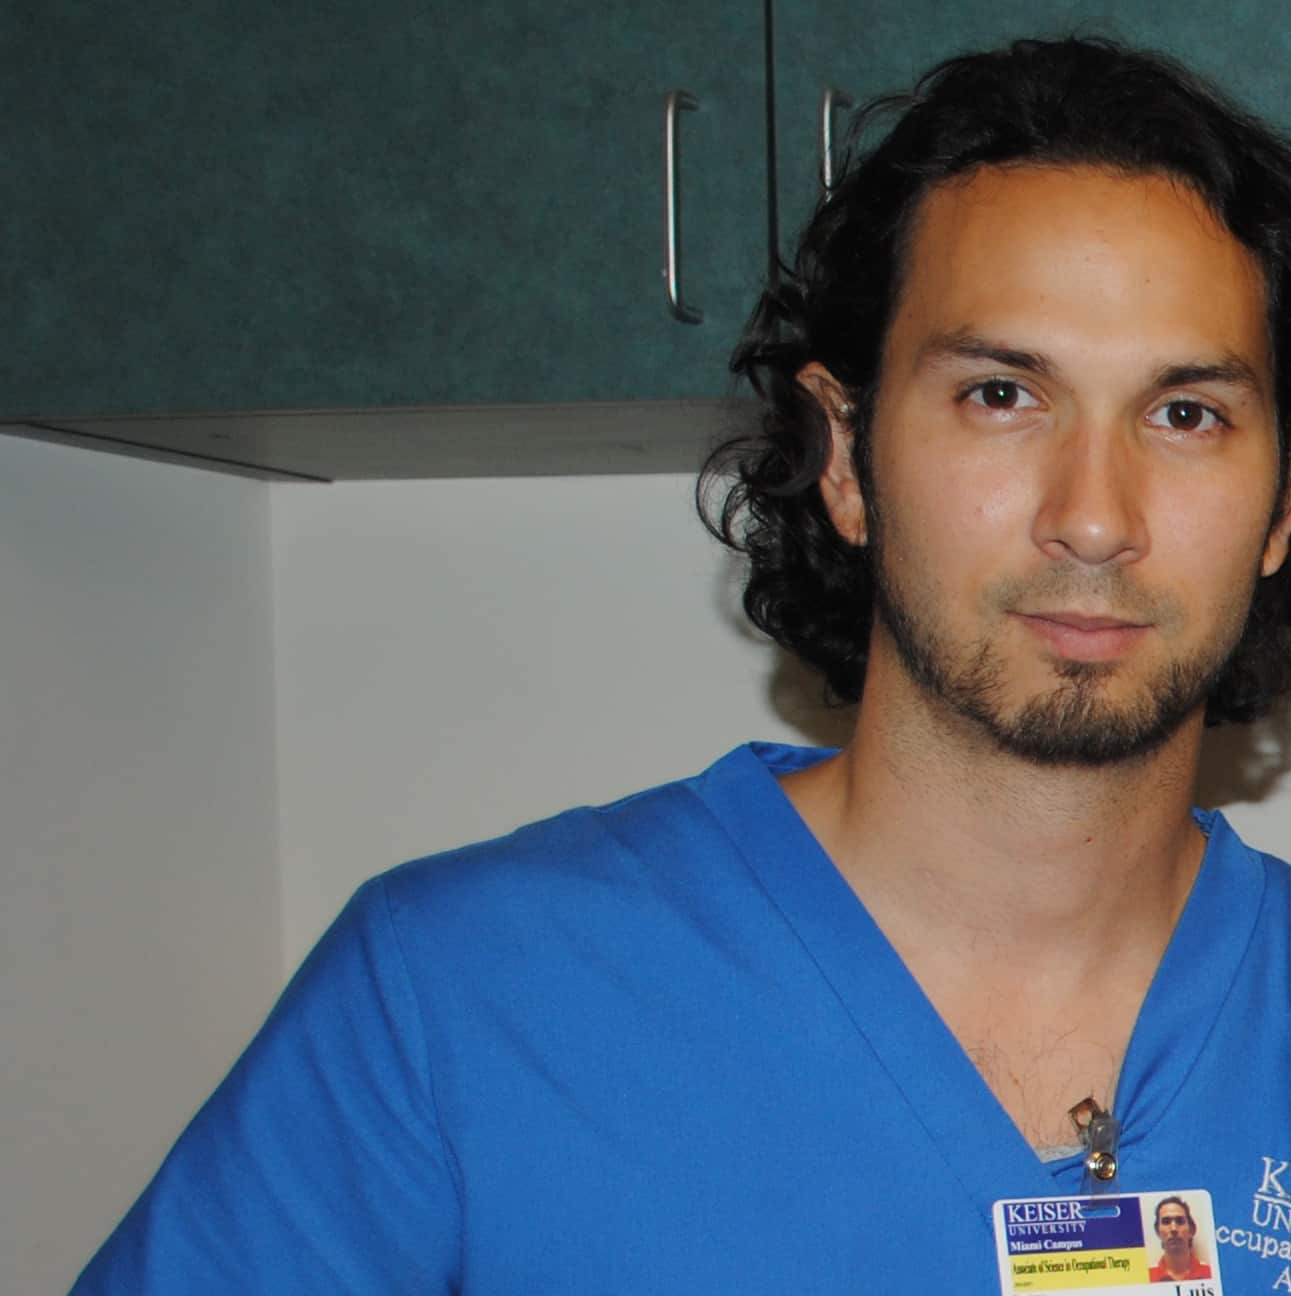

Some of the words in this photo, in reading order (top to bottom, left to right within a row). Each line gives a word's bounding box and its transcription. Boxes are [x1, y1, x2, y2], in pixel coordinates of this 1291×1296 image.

[1007, 1201, 1085, 1223] KEISER
[1008, 1221, 1087, 1236] UNIVERSITY
[1010, 1240, 1042, 1252] Miami
[1043, 1238, 1083, 1251] Campus
